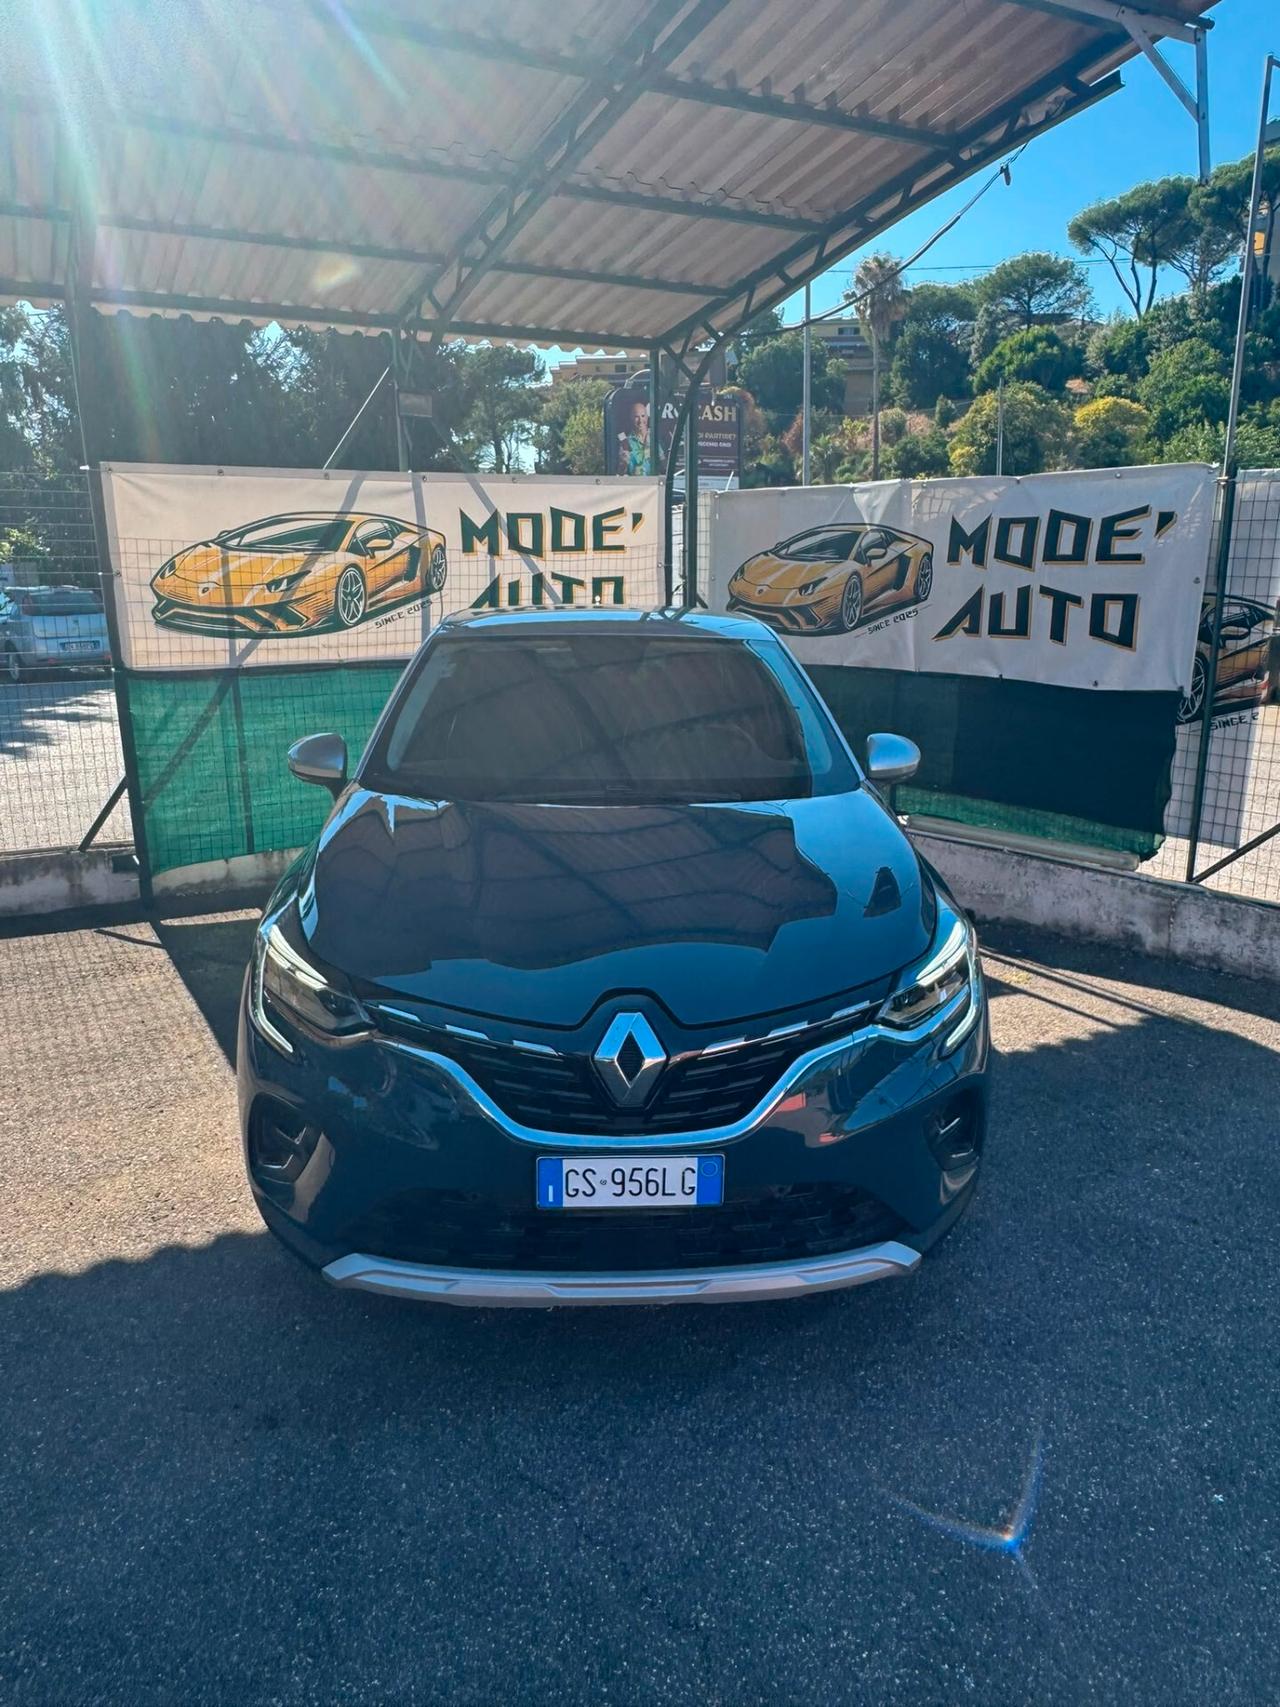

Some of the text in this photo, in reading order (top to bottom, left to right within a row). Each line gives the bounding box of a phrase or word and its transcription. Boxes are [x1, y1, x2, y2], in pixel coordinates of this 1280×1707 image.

[460, 506, 643, 559] MODE'
[946, 504, 1177, 572] MODE'
[375, 611, 405, 629] SINCE
[867, 608, 918, 635] SINCE 2025
[932, 584, 1141, 652] AUTO
[1210, 715, 1248, 731] SINCE
[565, 1167, 696, 1198] GS 956LG
